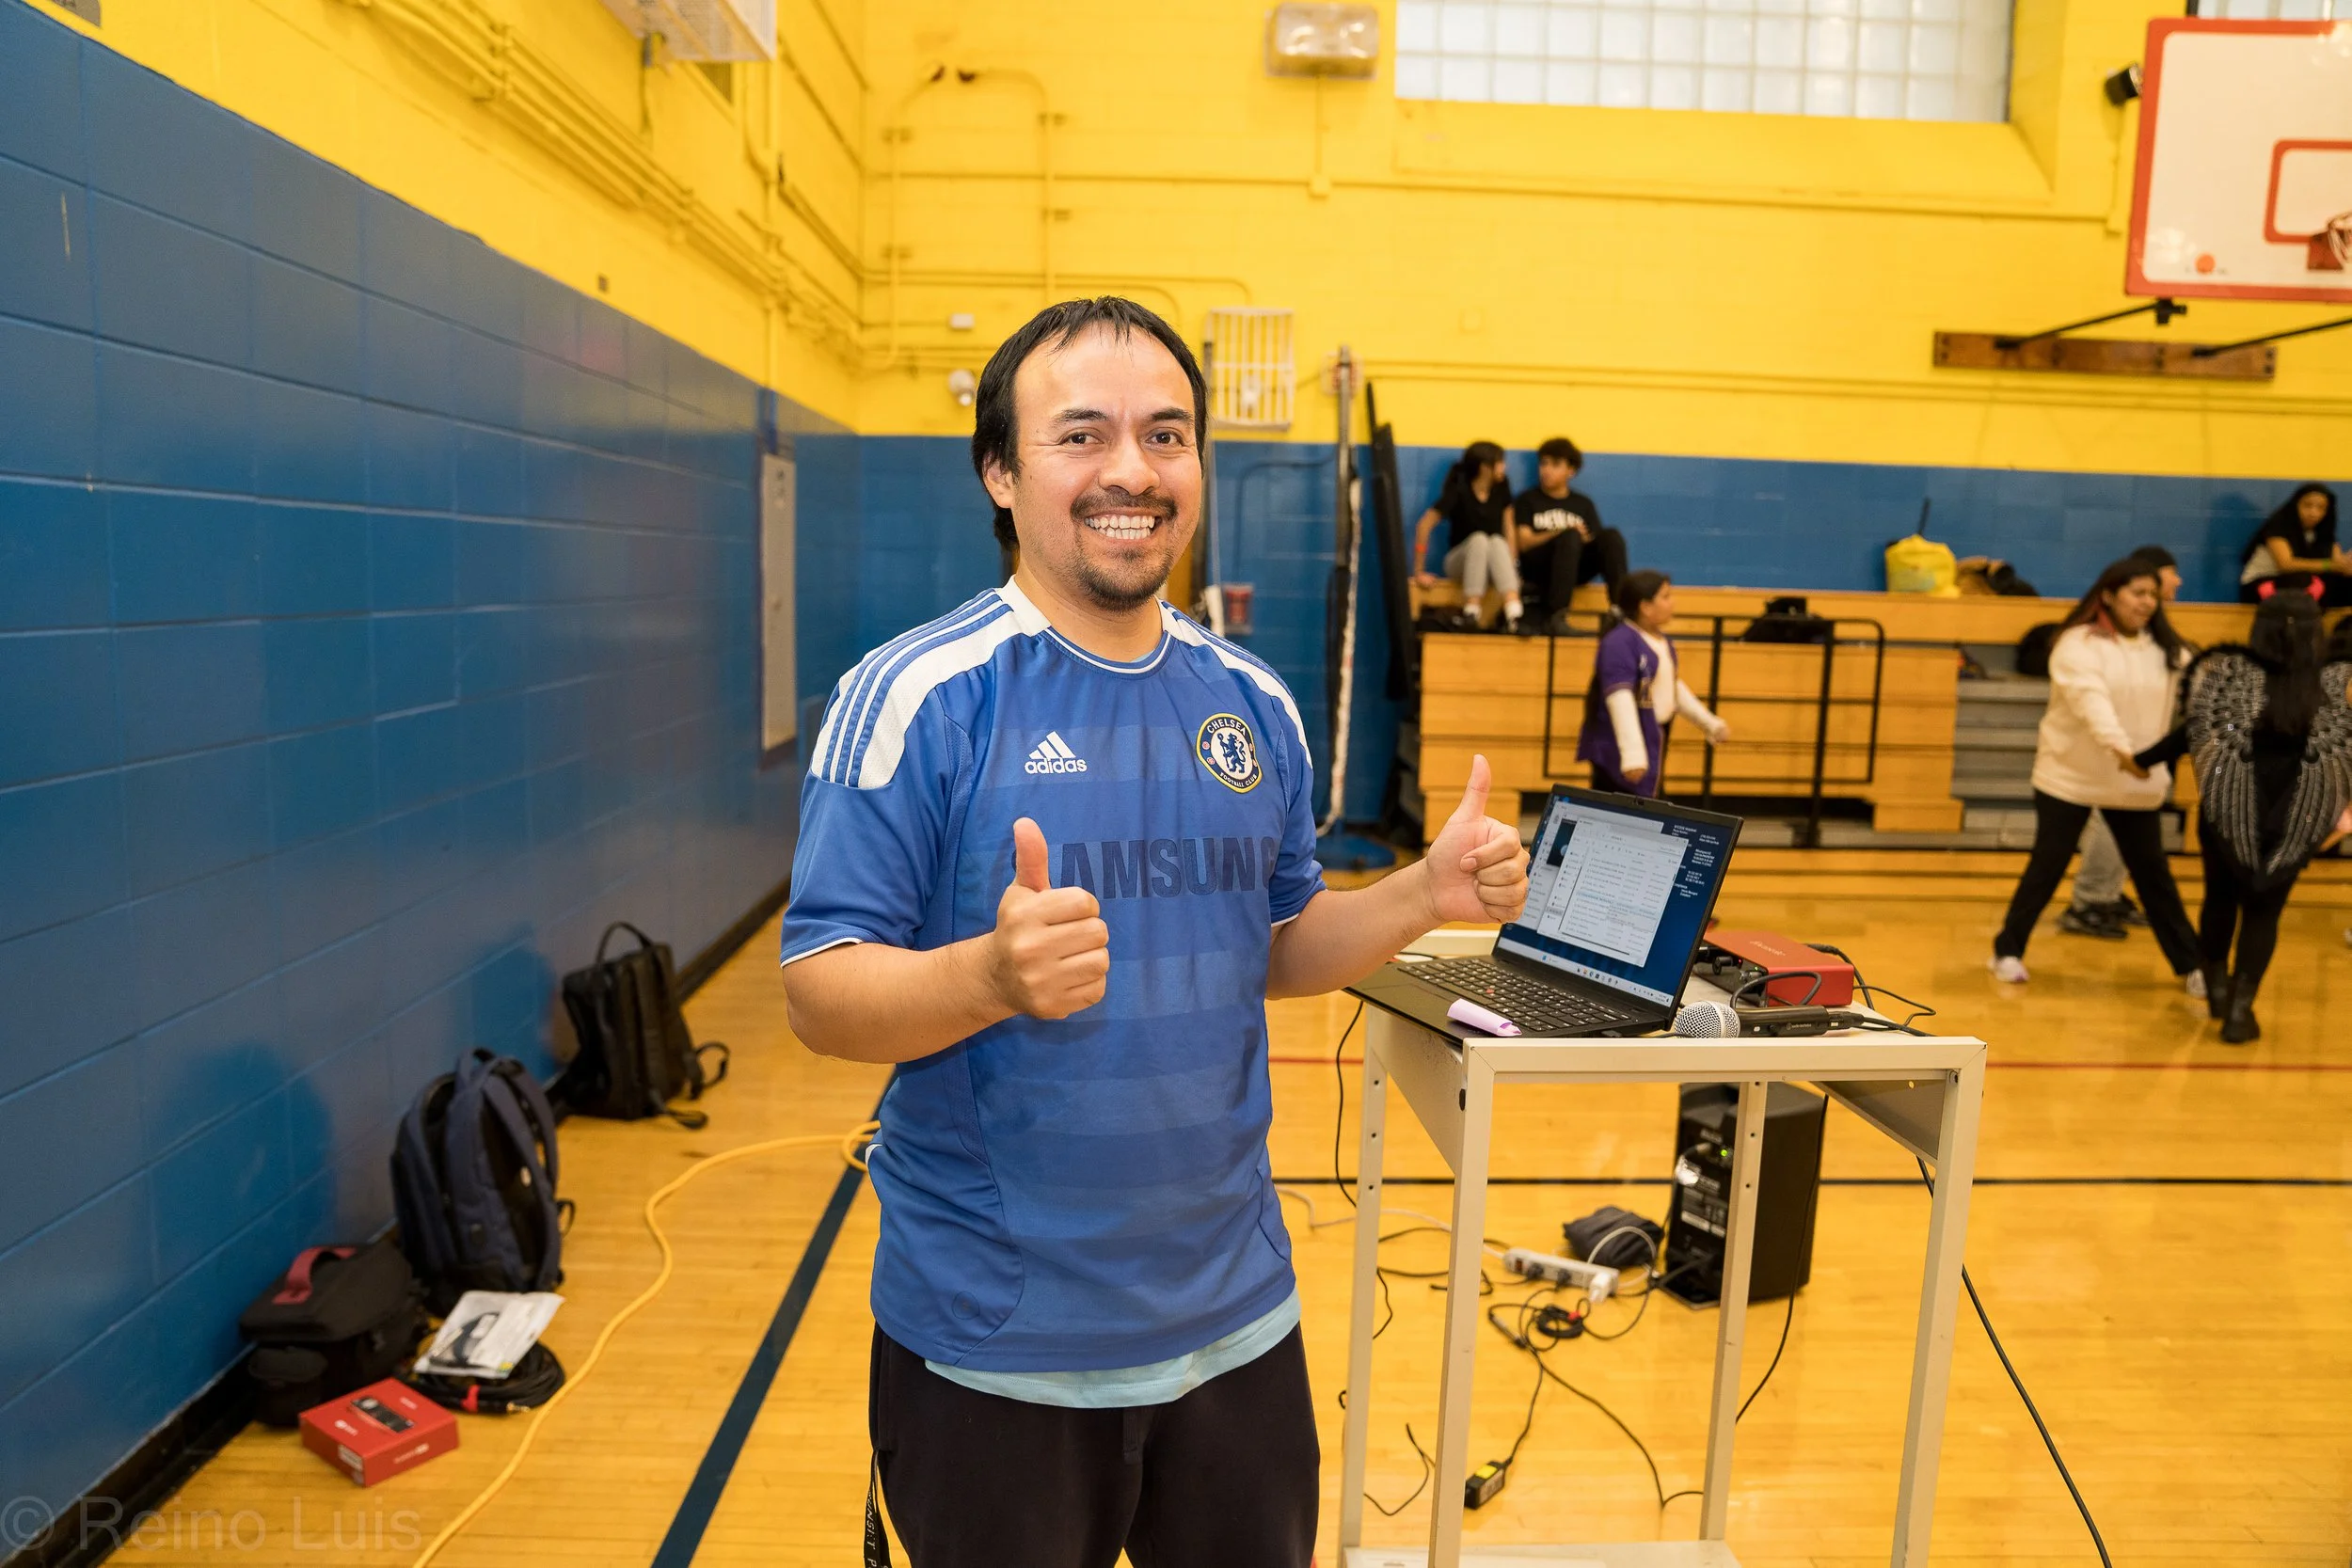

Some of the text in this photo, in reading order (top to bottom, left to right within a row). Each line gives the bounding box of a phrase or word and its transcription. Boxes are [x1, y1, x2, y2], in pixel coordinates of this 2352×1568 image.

[1206, 718, 1247, 736] CHELSEA
[1024, 756, 1088, 774] adidas
[1219, 771, 1258, 787] FOOTBALL CLUB
[1011, 836, 1276, 899] AMSUNG
